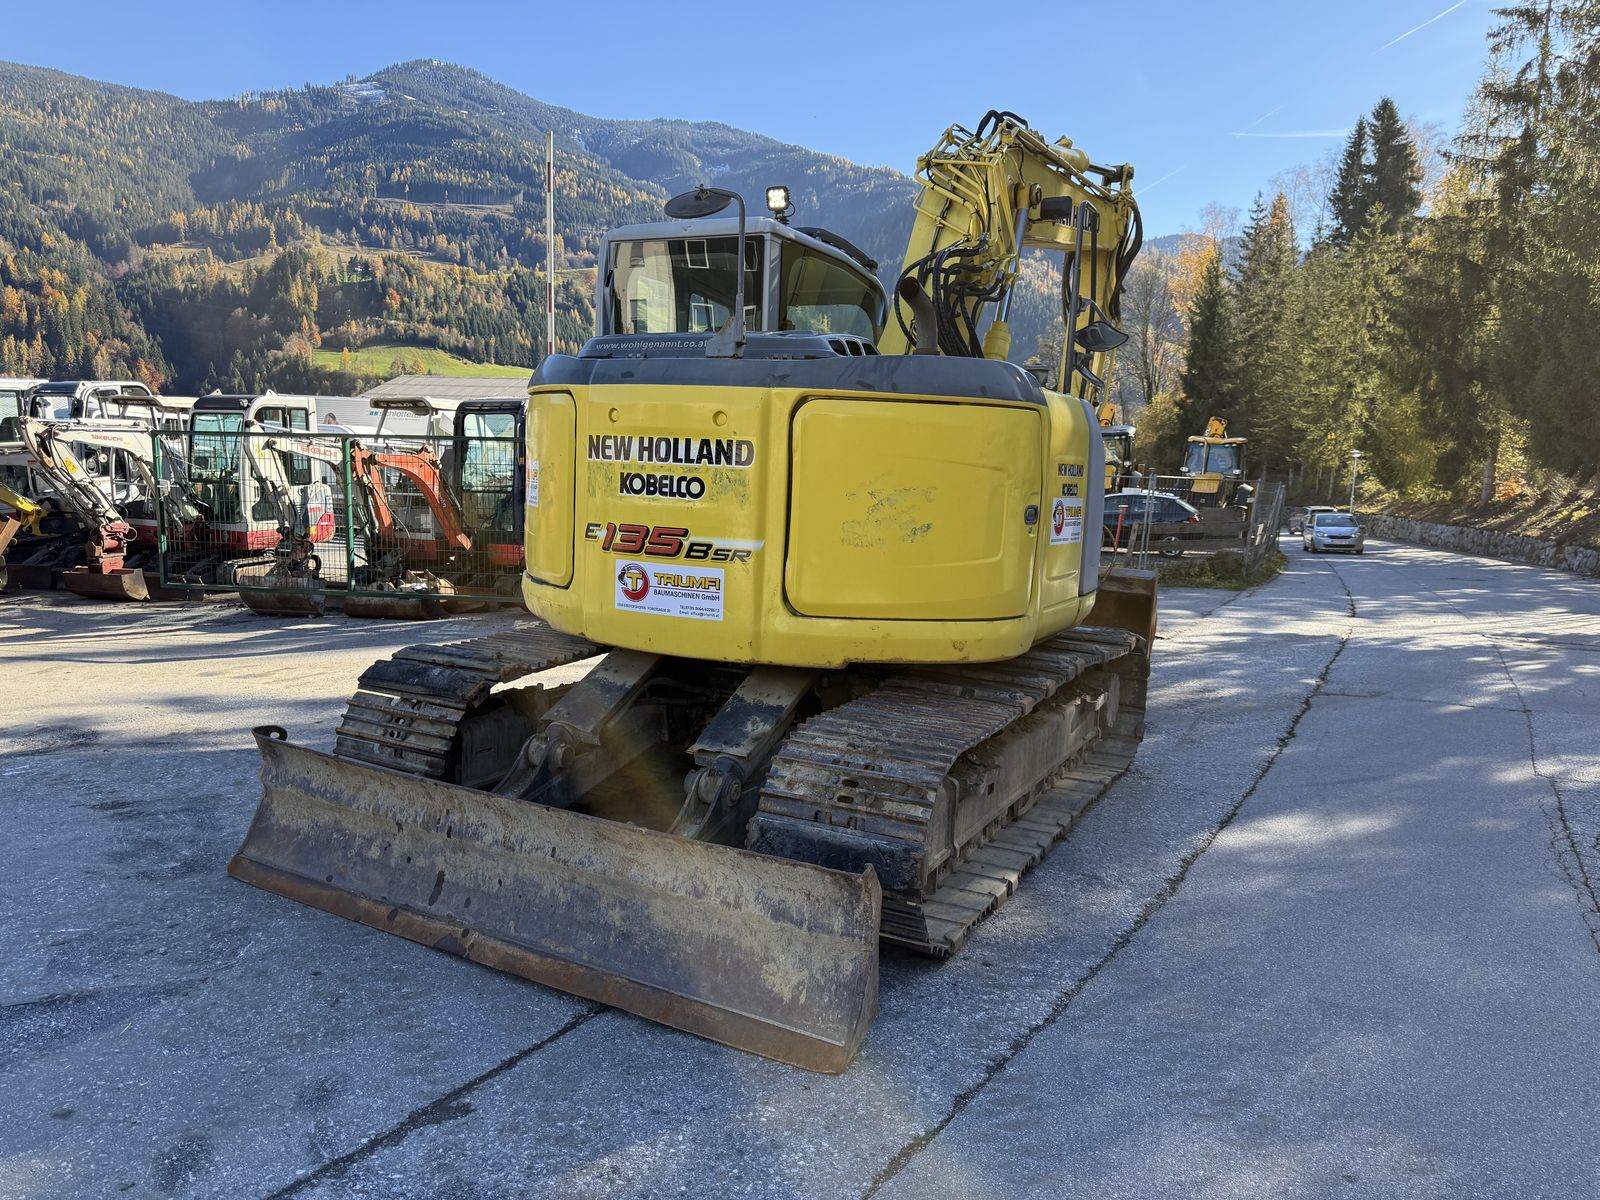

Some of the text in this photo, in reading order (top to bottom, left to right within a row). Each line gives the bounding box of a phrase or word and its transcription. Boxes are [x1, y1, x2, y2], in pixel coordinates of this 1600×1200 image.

[595, 340, 708, 350] www.wohlgenannt.co.at
[588, 434, 755, 467] NEW HOLLAND
[619, 471, 706, 500] KOBELCO
[653, 572, 721, 591] TRIUMFI
[653, 589, 720, 602] BAUMASCHINEN GmbH
